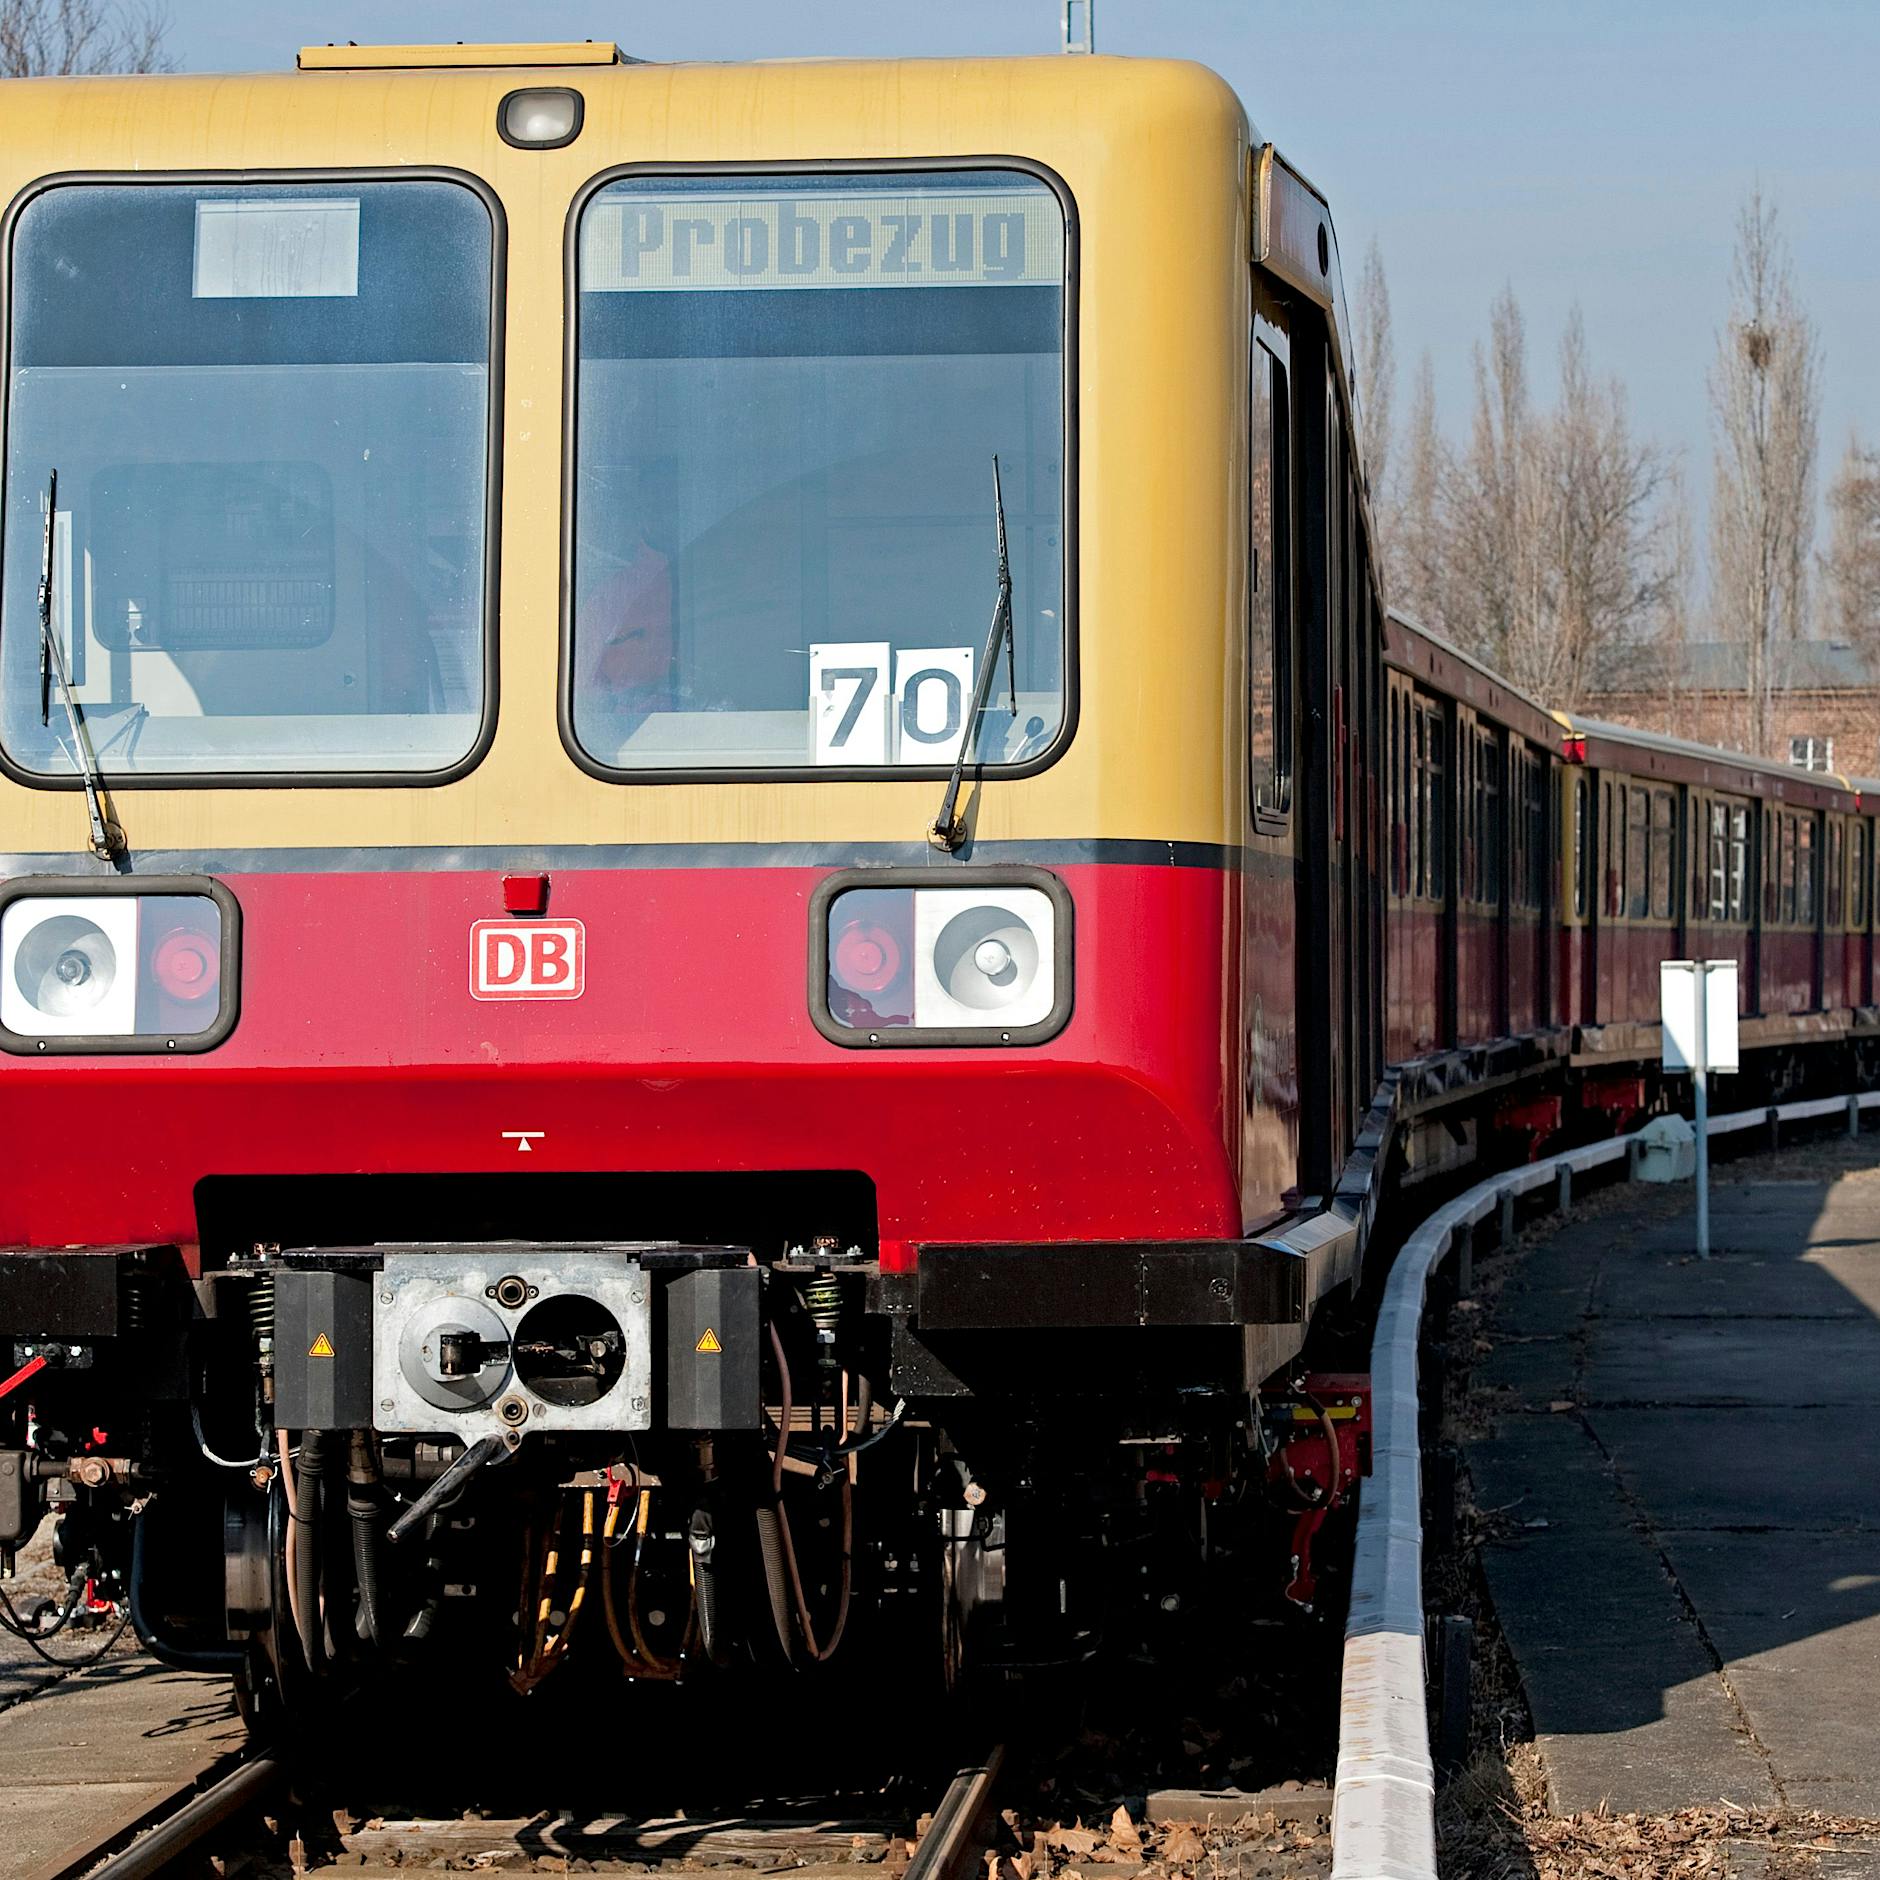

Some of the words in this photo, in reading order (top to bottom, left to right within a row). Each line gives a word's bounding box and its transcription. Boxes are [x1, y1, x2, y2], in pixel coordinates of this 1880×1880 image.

[620, 203, 1026, 281] Probezug
[821, 667, 962, 747] 70
[486, 933, 570, 985] DB
